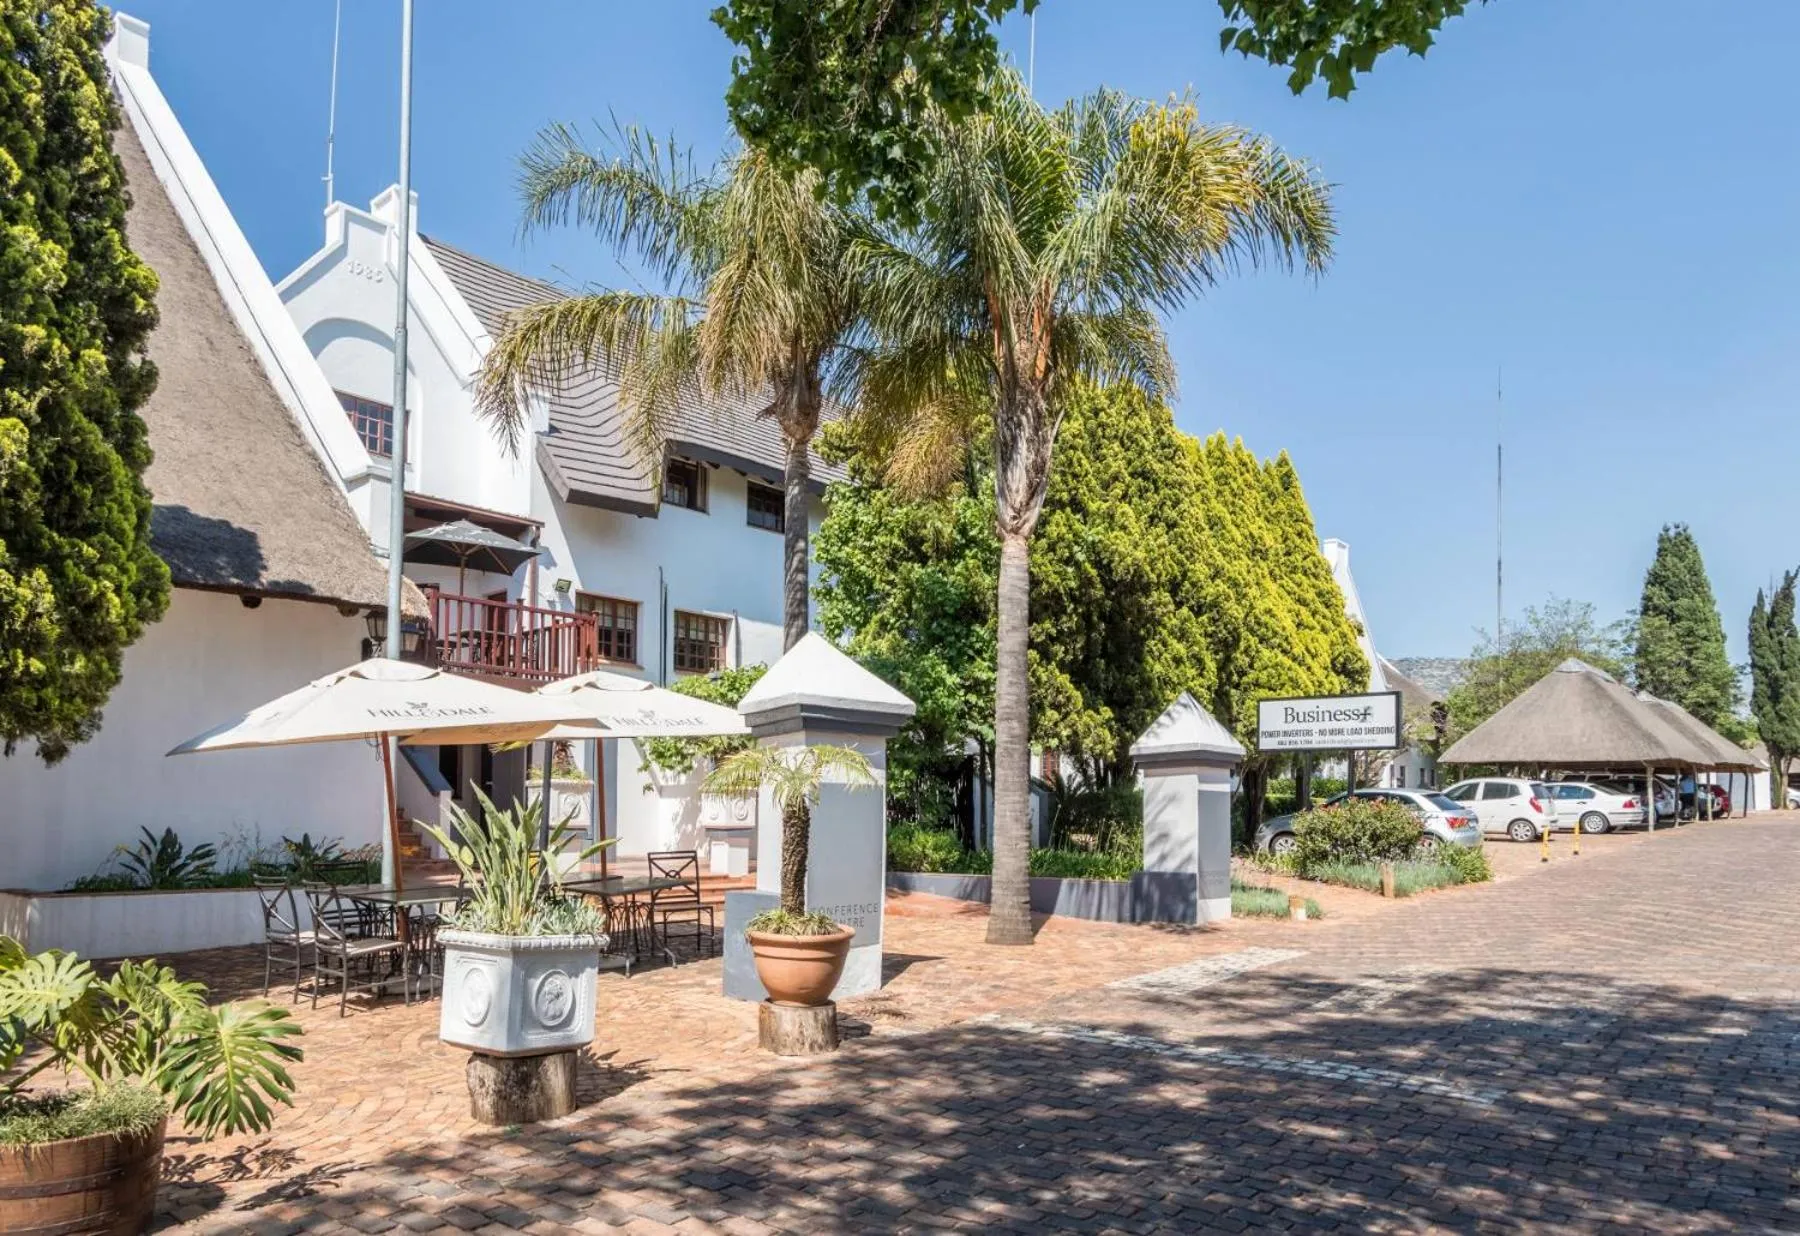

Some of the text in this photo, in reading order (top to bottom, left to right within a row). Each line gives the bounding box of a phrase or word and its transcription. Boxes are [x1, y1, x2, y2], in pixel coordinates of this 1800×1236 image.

[1261, 730, 1281, 738] POWER
[1282, 729, 1313, 738] INVERTERS
[1328, 728, 1345, 736] MORE
[1364, 726, 1396, 735] SHEDDING
